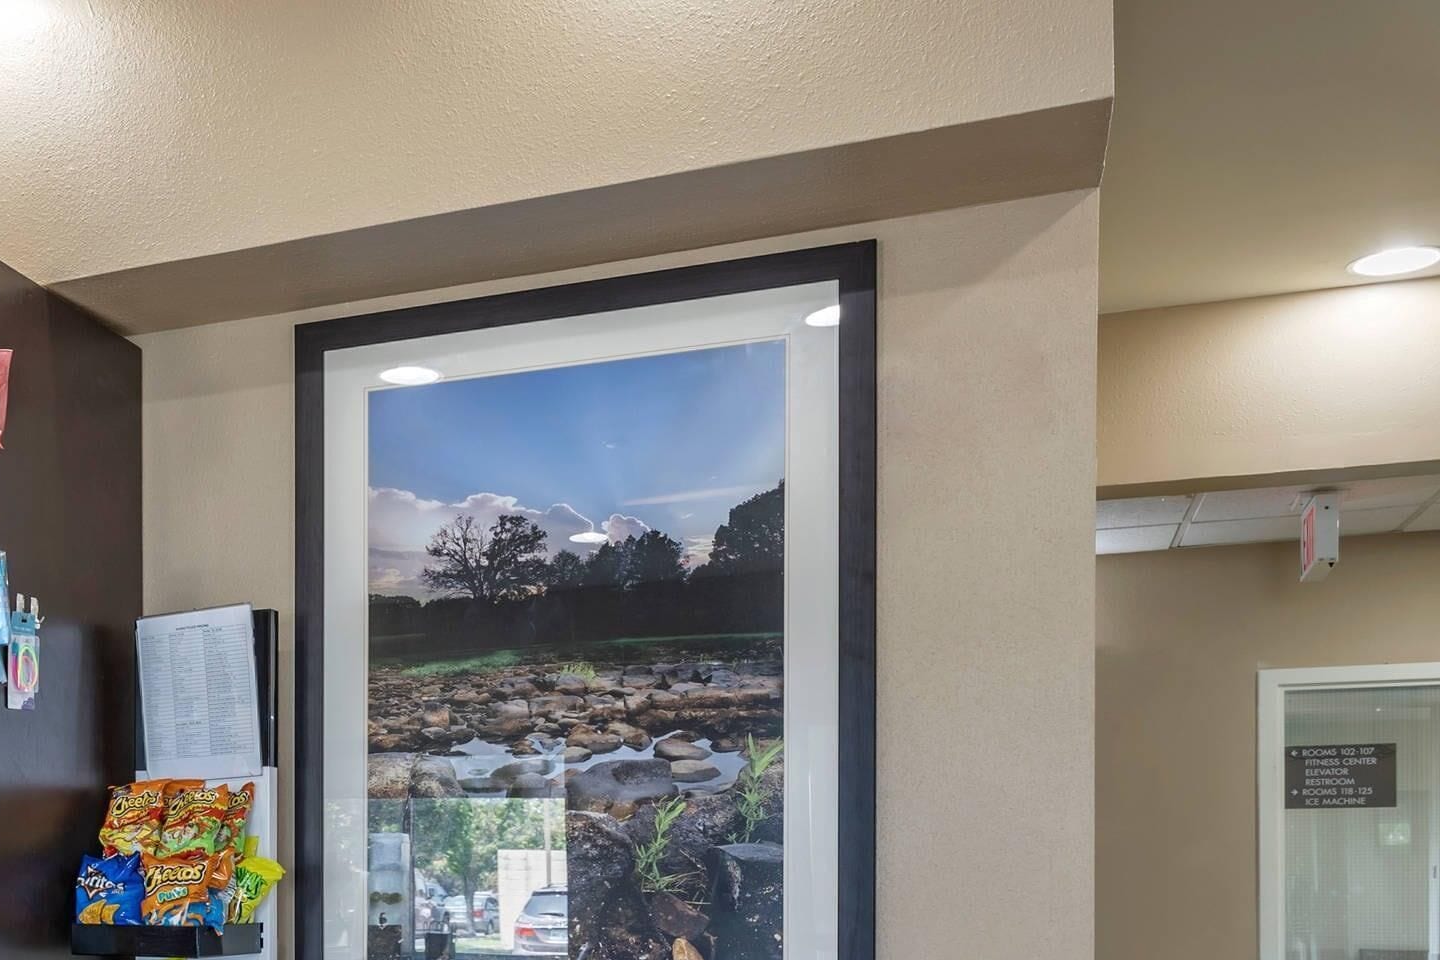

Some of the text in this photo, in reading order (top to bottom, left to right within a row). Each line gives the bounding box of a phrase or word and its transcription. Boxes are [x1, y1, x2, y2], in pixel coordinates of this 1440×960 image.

[1302, 749, 1337, 757] ROOMS
[1305, 757, 1377, 766] FITNESS CENTER
[1305, 768, 1350, 776] ELEVATOR
[1305, 778, 1356, 786] RESTROOM
[1302, 788, 1338, 796] ROOMS
[170, 790, 218, 815] Cheetos
[1305, 797, 1366, 806] ICE MACHINE
[146, 864, 206, 895] Cheetos
